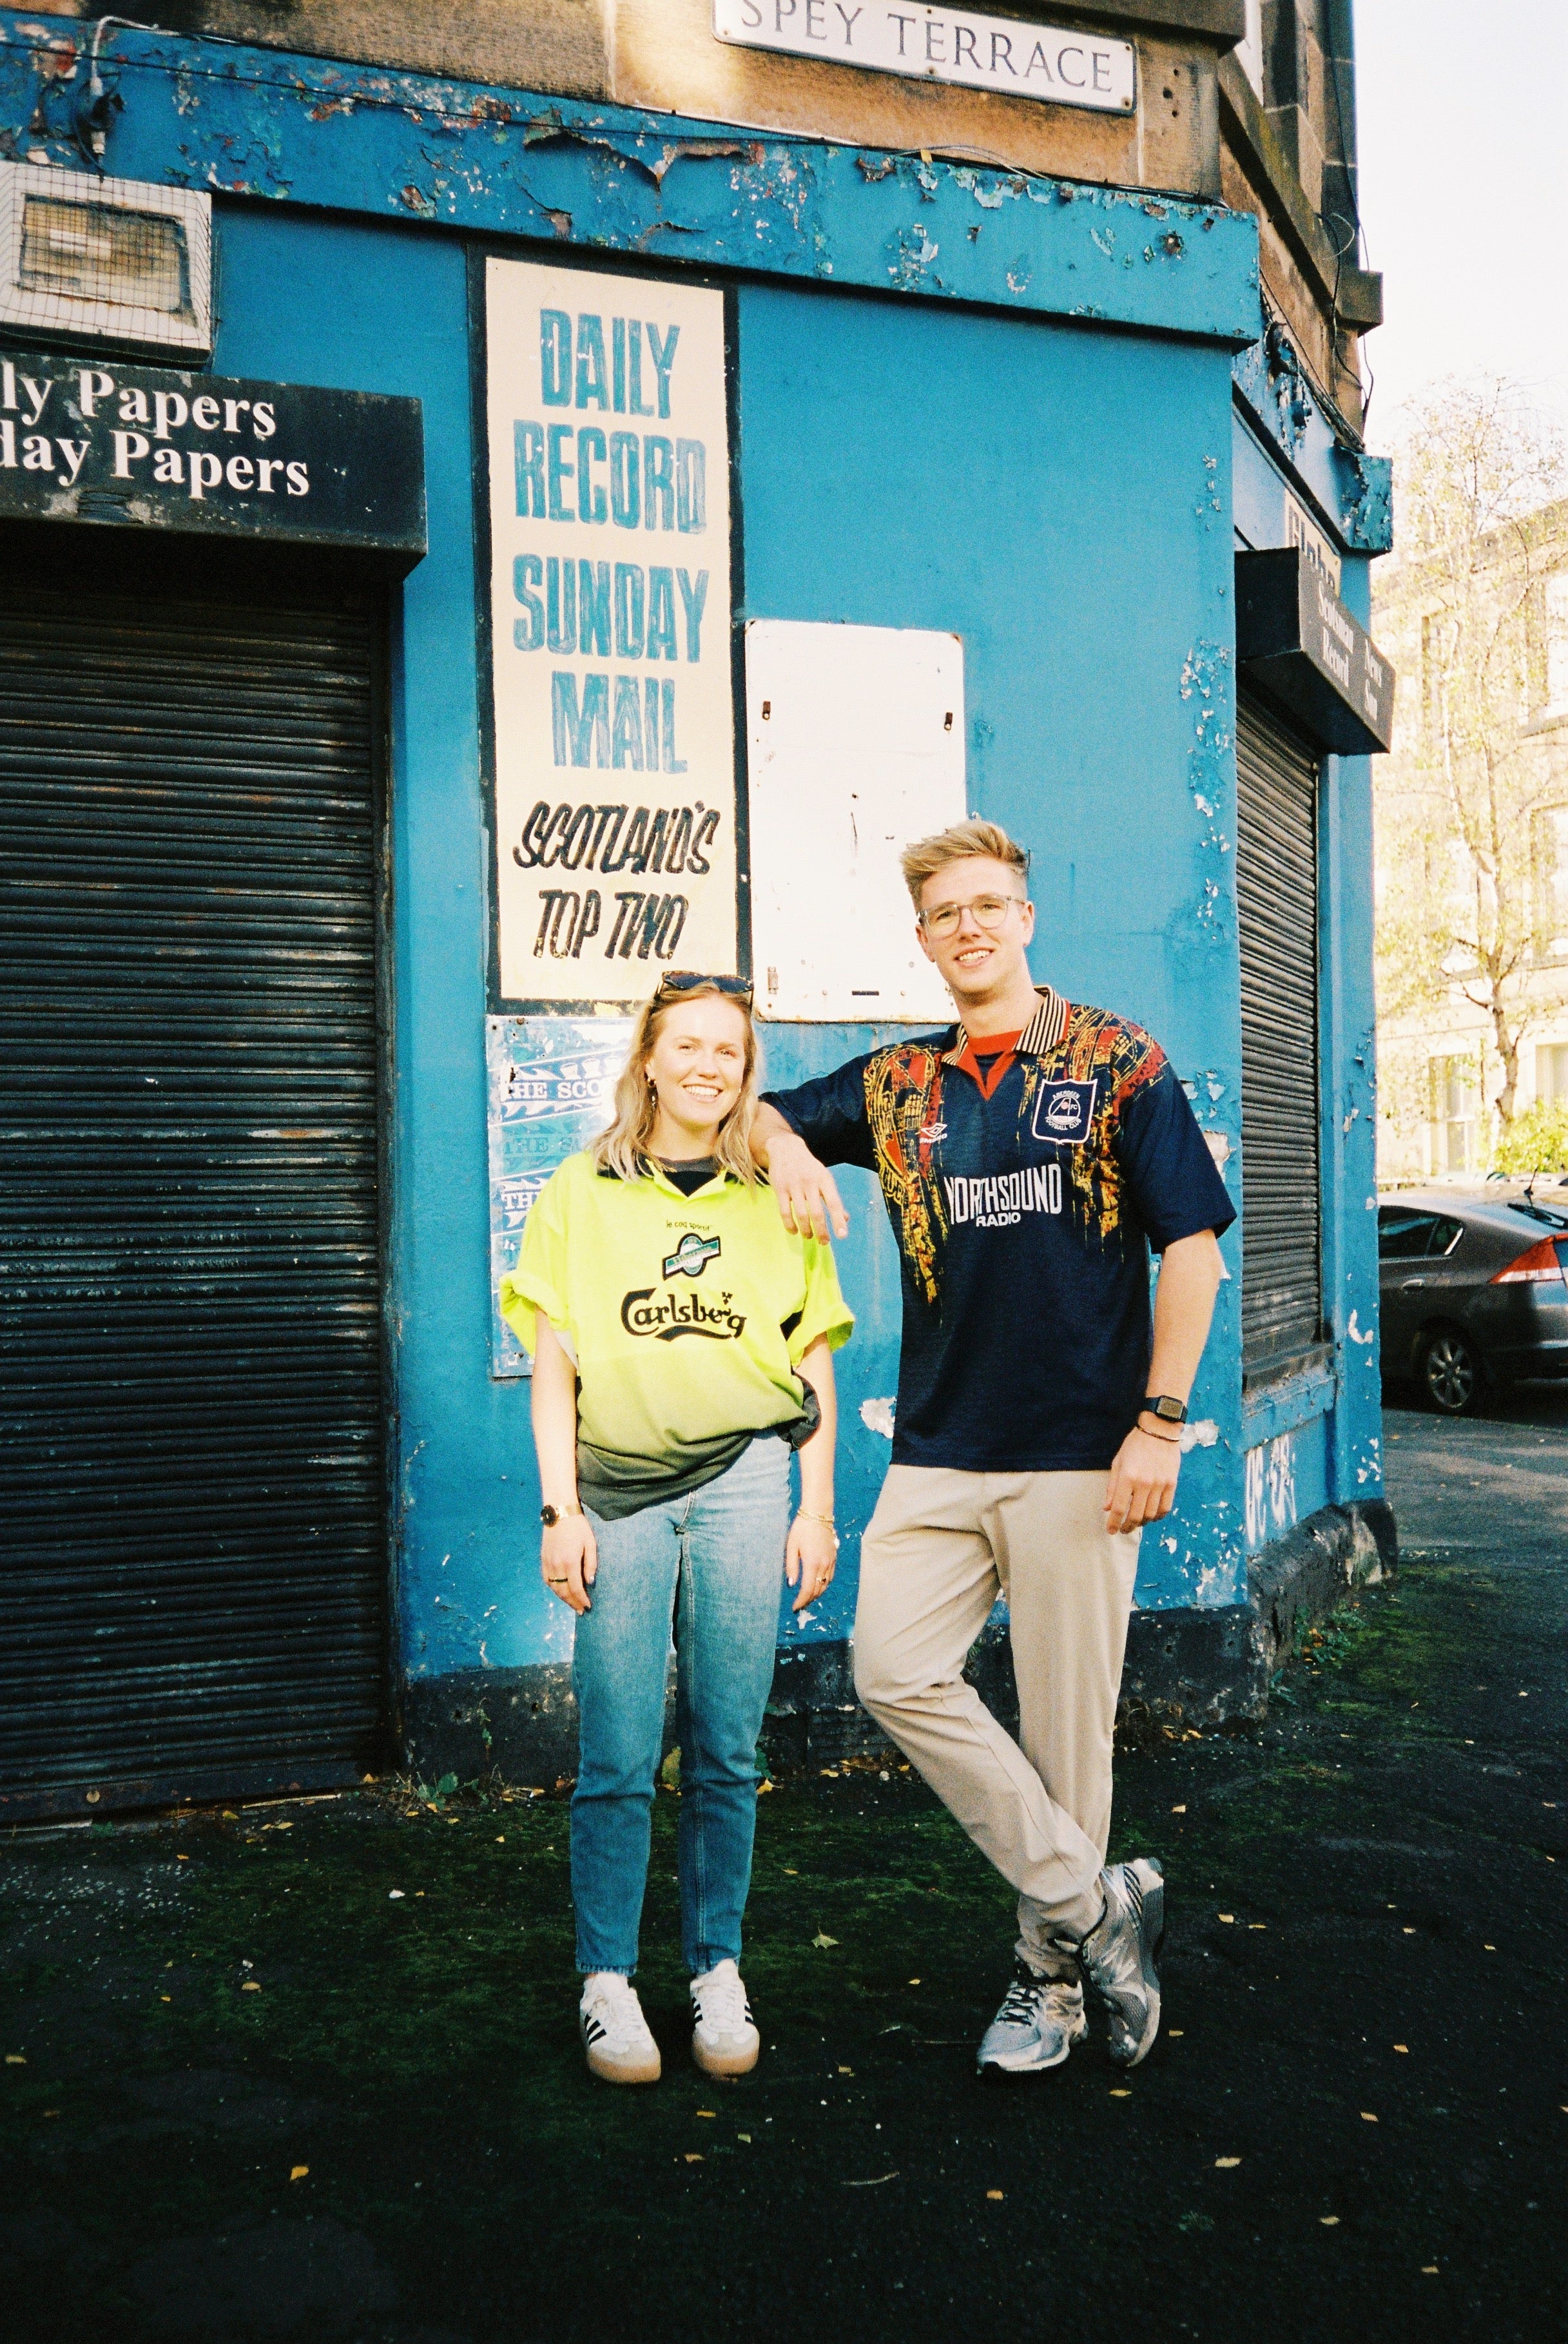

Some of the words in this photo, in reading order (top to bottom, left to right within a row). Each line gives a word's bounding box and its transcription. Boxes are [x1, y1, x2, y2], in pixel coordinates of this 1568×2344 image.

[741, 0, 866, 46] SPEY
[887, 13, 1113, 93] TERRACE
[539, 308, 681, 420] DAILY
[75, 370, 276, 440] Papers
[110, 429, 309, 500] Papers
[513, 419, 707, 535] RECORD
[512, 552, 710, 663] SUNDAY
[551, 670, 688, 774] MAIL
[512, 800, 721, 875] SCOTLAND'S
[532, 889, 602, 959] TOP
[604, 890, 690, 960] TWO
[501, 1192, 540, 1210] TH
[666, 1219, 672, 1228] le
[976, 1212, 1021, 1227] RADIO
[621, 1288, 747, 1339] Carlsberg
